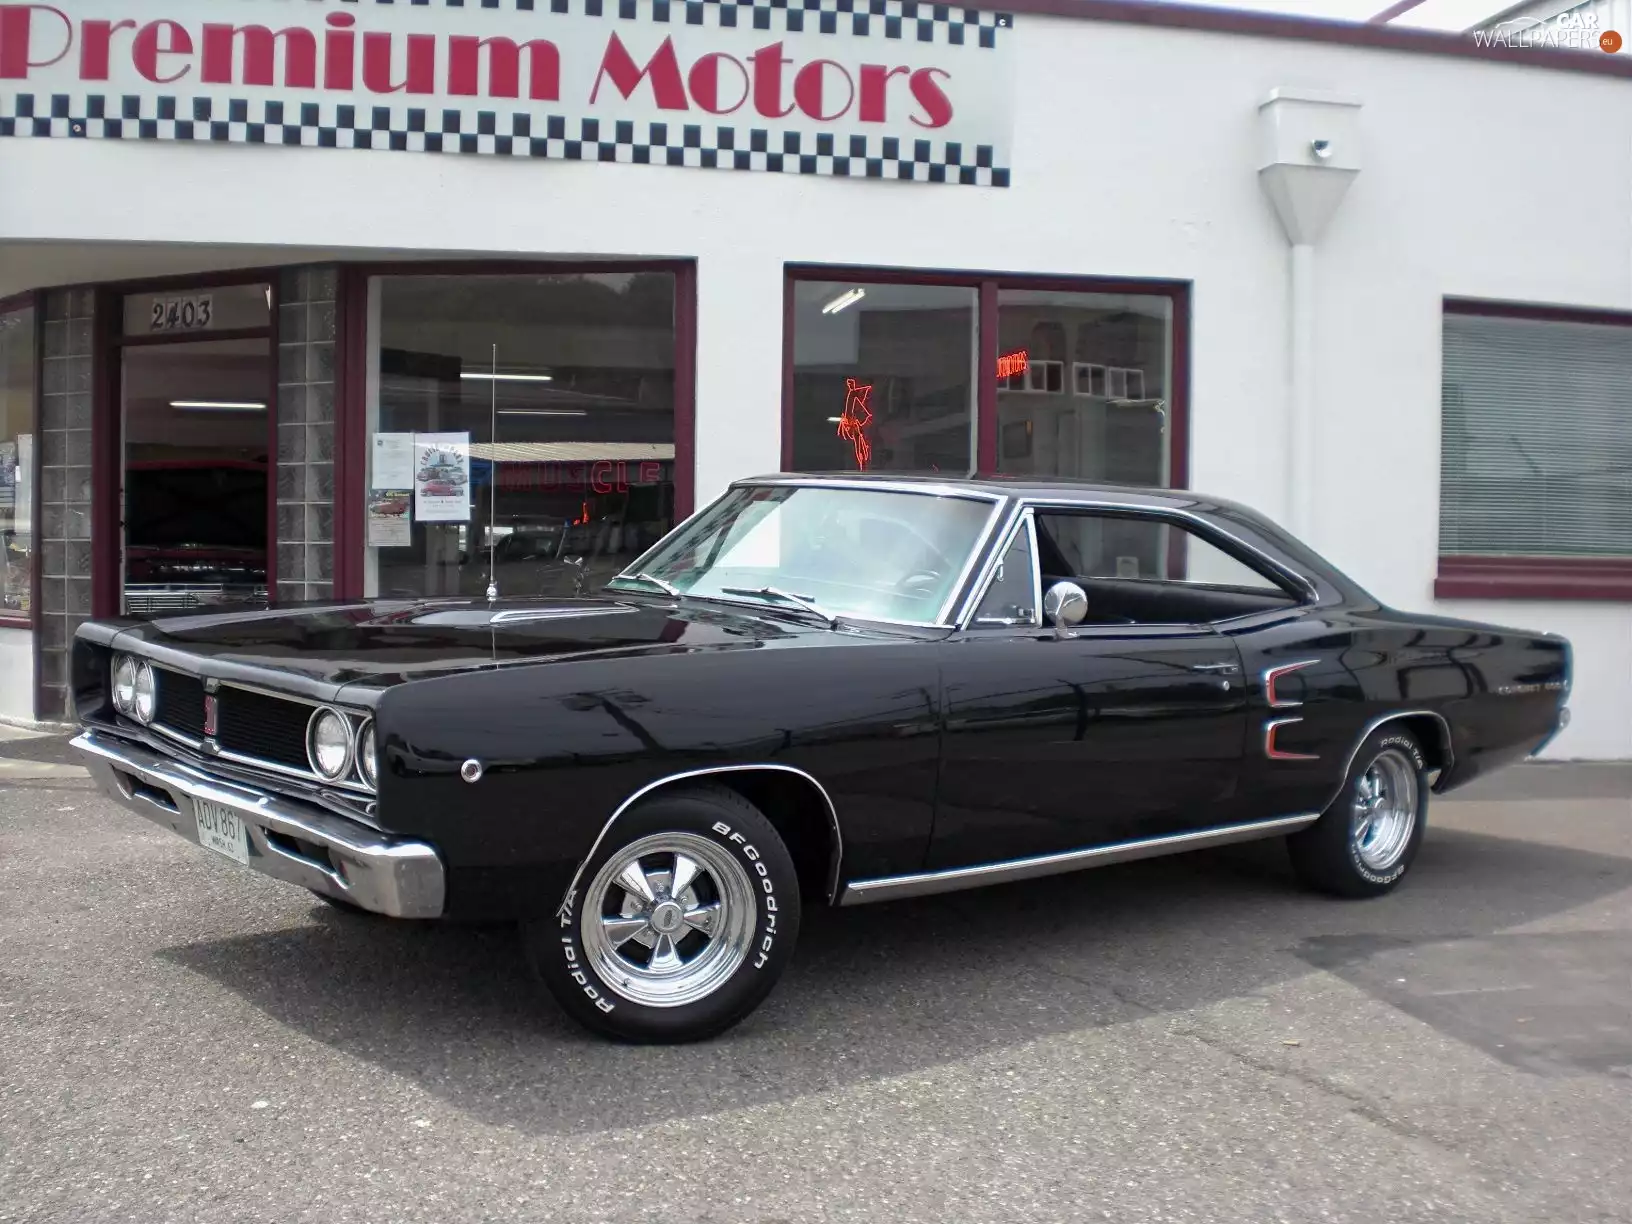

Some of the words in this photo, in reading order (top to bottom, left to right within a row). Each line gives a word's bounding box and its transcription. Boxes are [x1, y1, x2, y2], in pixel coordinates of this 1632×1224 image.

[0, 4, 560, 101] Premium
[589, 30, 953, 129] Motors
[150, 300, 211, 331] 2403
[196, 799, 218, 833] ADV
[220, 807, 240, 843] 867
[711, 821, 778, 969] BFGoodrich
[561, 937, 615, 1013] Radial
